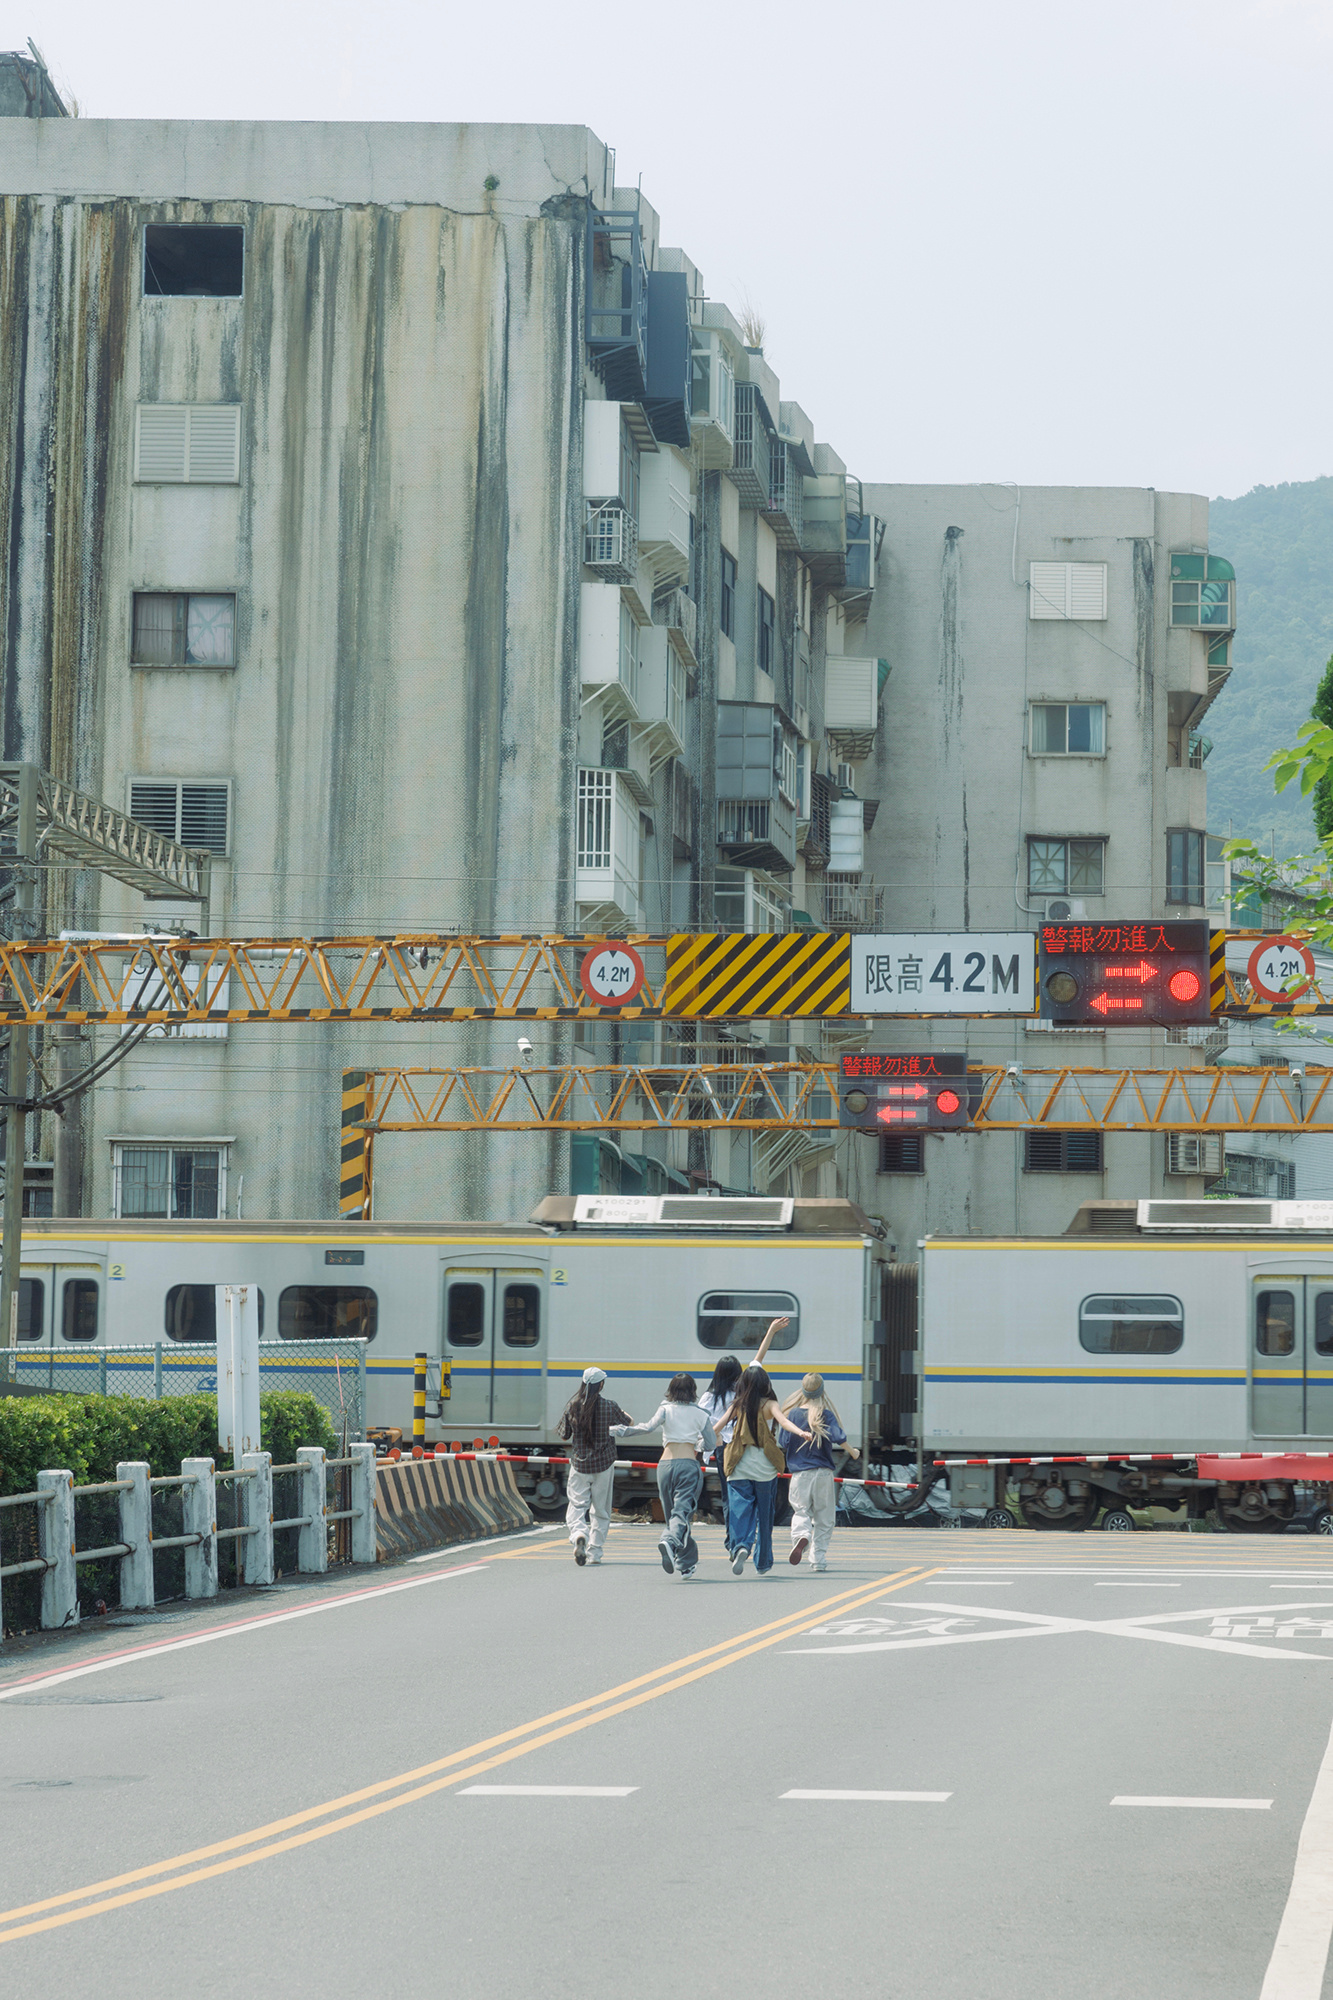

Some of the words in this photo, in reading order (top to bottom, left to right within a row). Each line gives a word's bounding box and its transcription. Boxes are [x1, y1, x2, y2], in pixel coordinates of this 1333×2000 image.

[1042, 925, 1175, 953] 警報勿進入
[596, 965, 630, 983] 4.2M
[865, 952, 1020, 994] 限高4.2M
[1265, 960, 1300, 978] 4.2M
[842, 1056, 942, 1076] 警報勿進入
[112, 1265, 122, 1276] 2
[554, 1270, 564, 1281] 2
